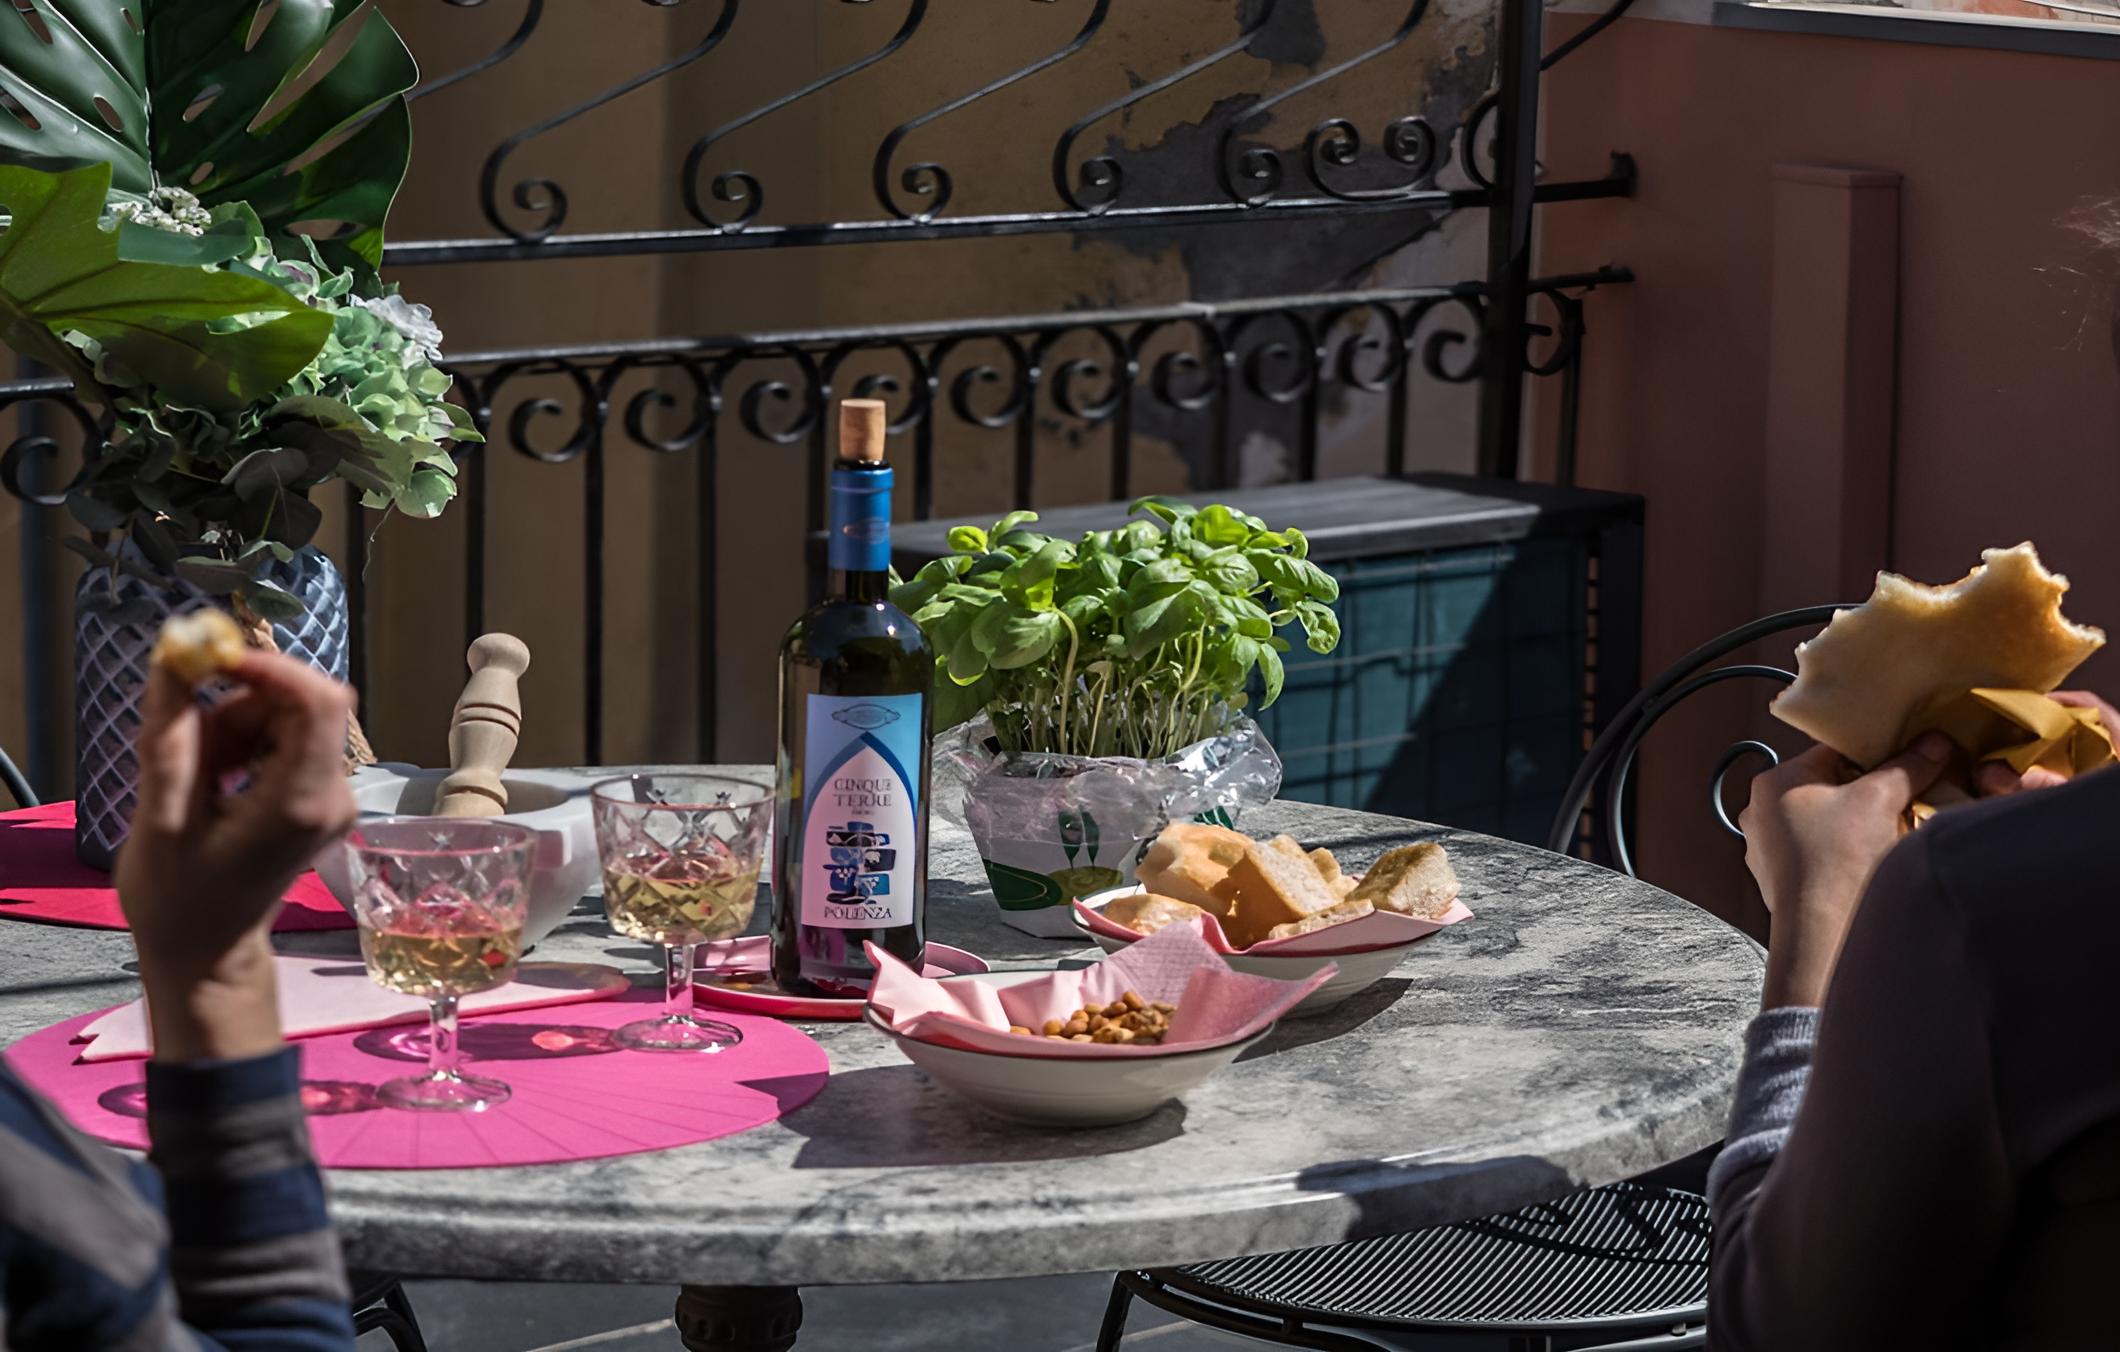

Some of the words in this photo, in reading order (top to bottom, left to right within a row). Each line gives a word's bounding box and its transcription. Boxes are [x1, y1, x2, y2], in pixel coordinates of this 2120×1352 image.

[833, 778, 892, 793] CINQUE
[832, 793, 892, 807] TERRE
[823, 906, 892, 920] POLENZA
